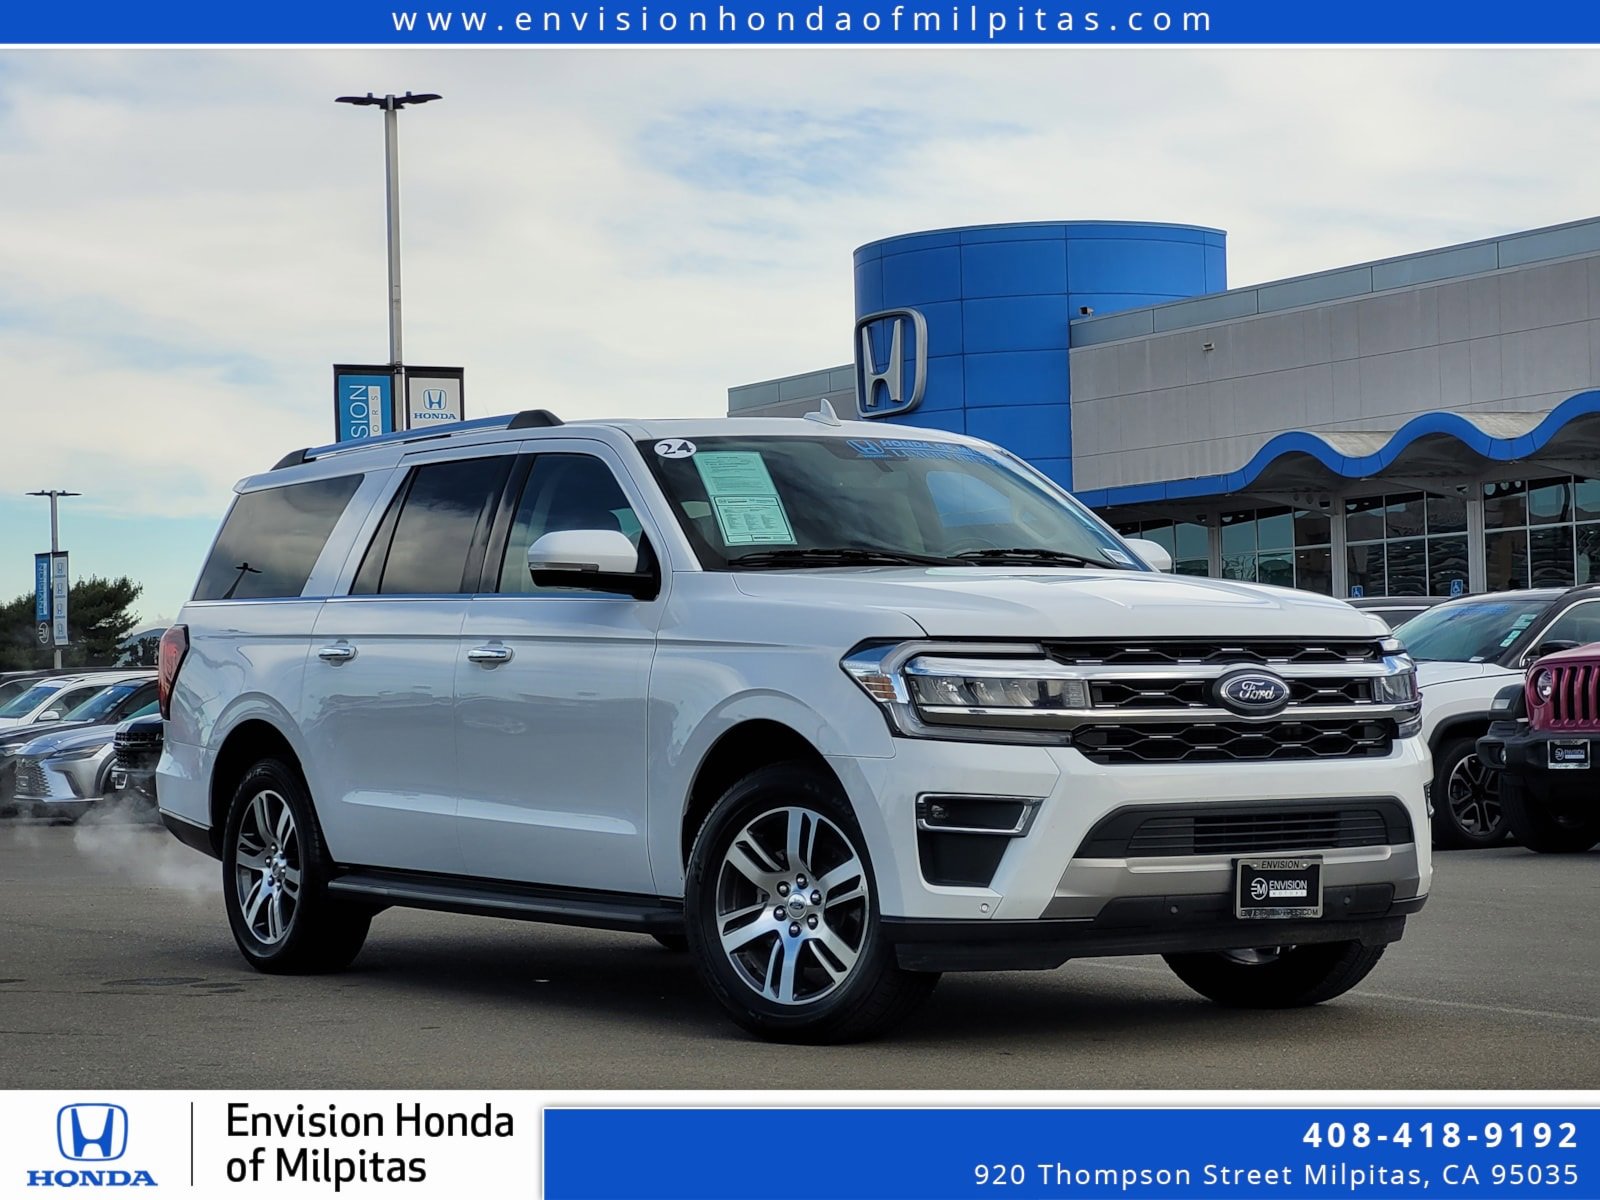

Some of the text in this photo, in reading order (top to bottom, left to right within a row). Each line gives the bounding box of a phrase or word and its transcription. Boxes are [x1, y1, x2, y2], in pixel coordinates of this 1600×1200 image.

[414, 412, 456, 420] HONDA
[658, 442, 693, 455] 24
[1239, 681, 1276, 700] Ford
[1261, 860, 1300, 869] ENVISION
[1269, 880, 1307, 890] ENVISION
